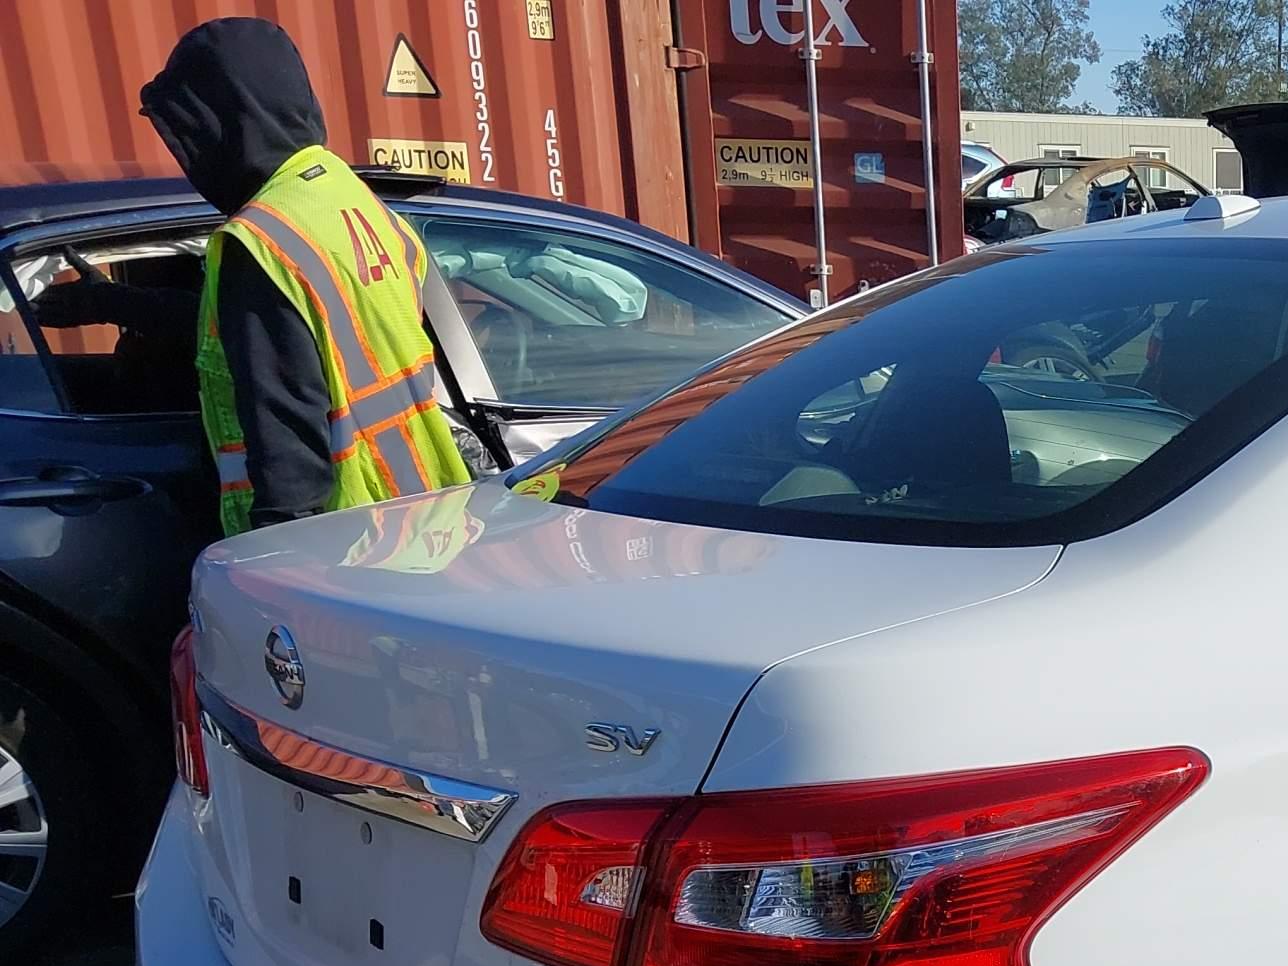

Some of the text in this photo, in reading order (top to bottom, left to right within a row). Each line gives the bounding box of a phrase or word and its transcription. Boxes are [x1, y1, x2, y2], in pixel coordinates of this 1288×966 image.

[464, 0, 495, 182] 609322
[374, 148, 465, 170] CAUTION
[720, 145, 808, 165] CAUTION
[856, 155, 884, 174] GL
[779, 170, 809, 183] HIGH
[584, 722, 662, 756] SV
